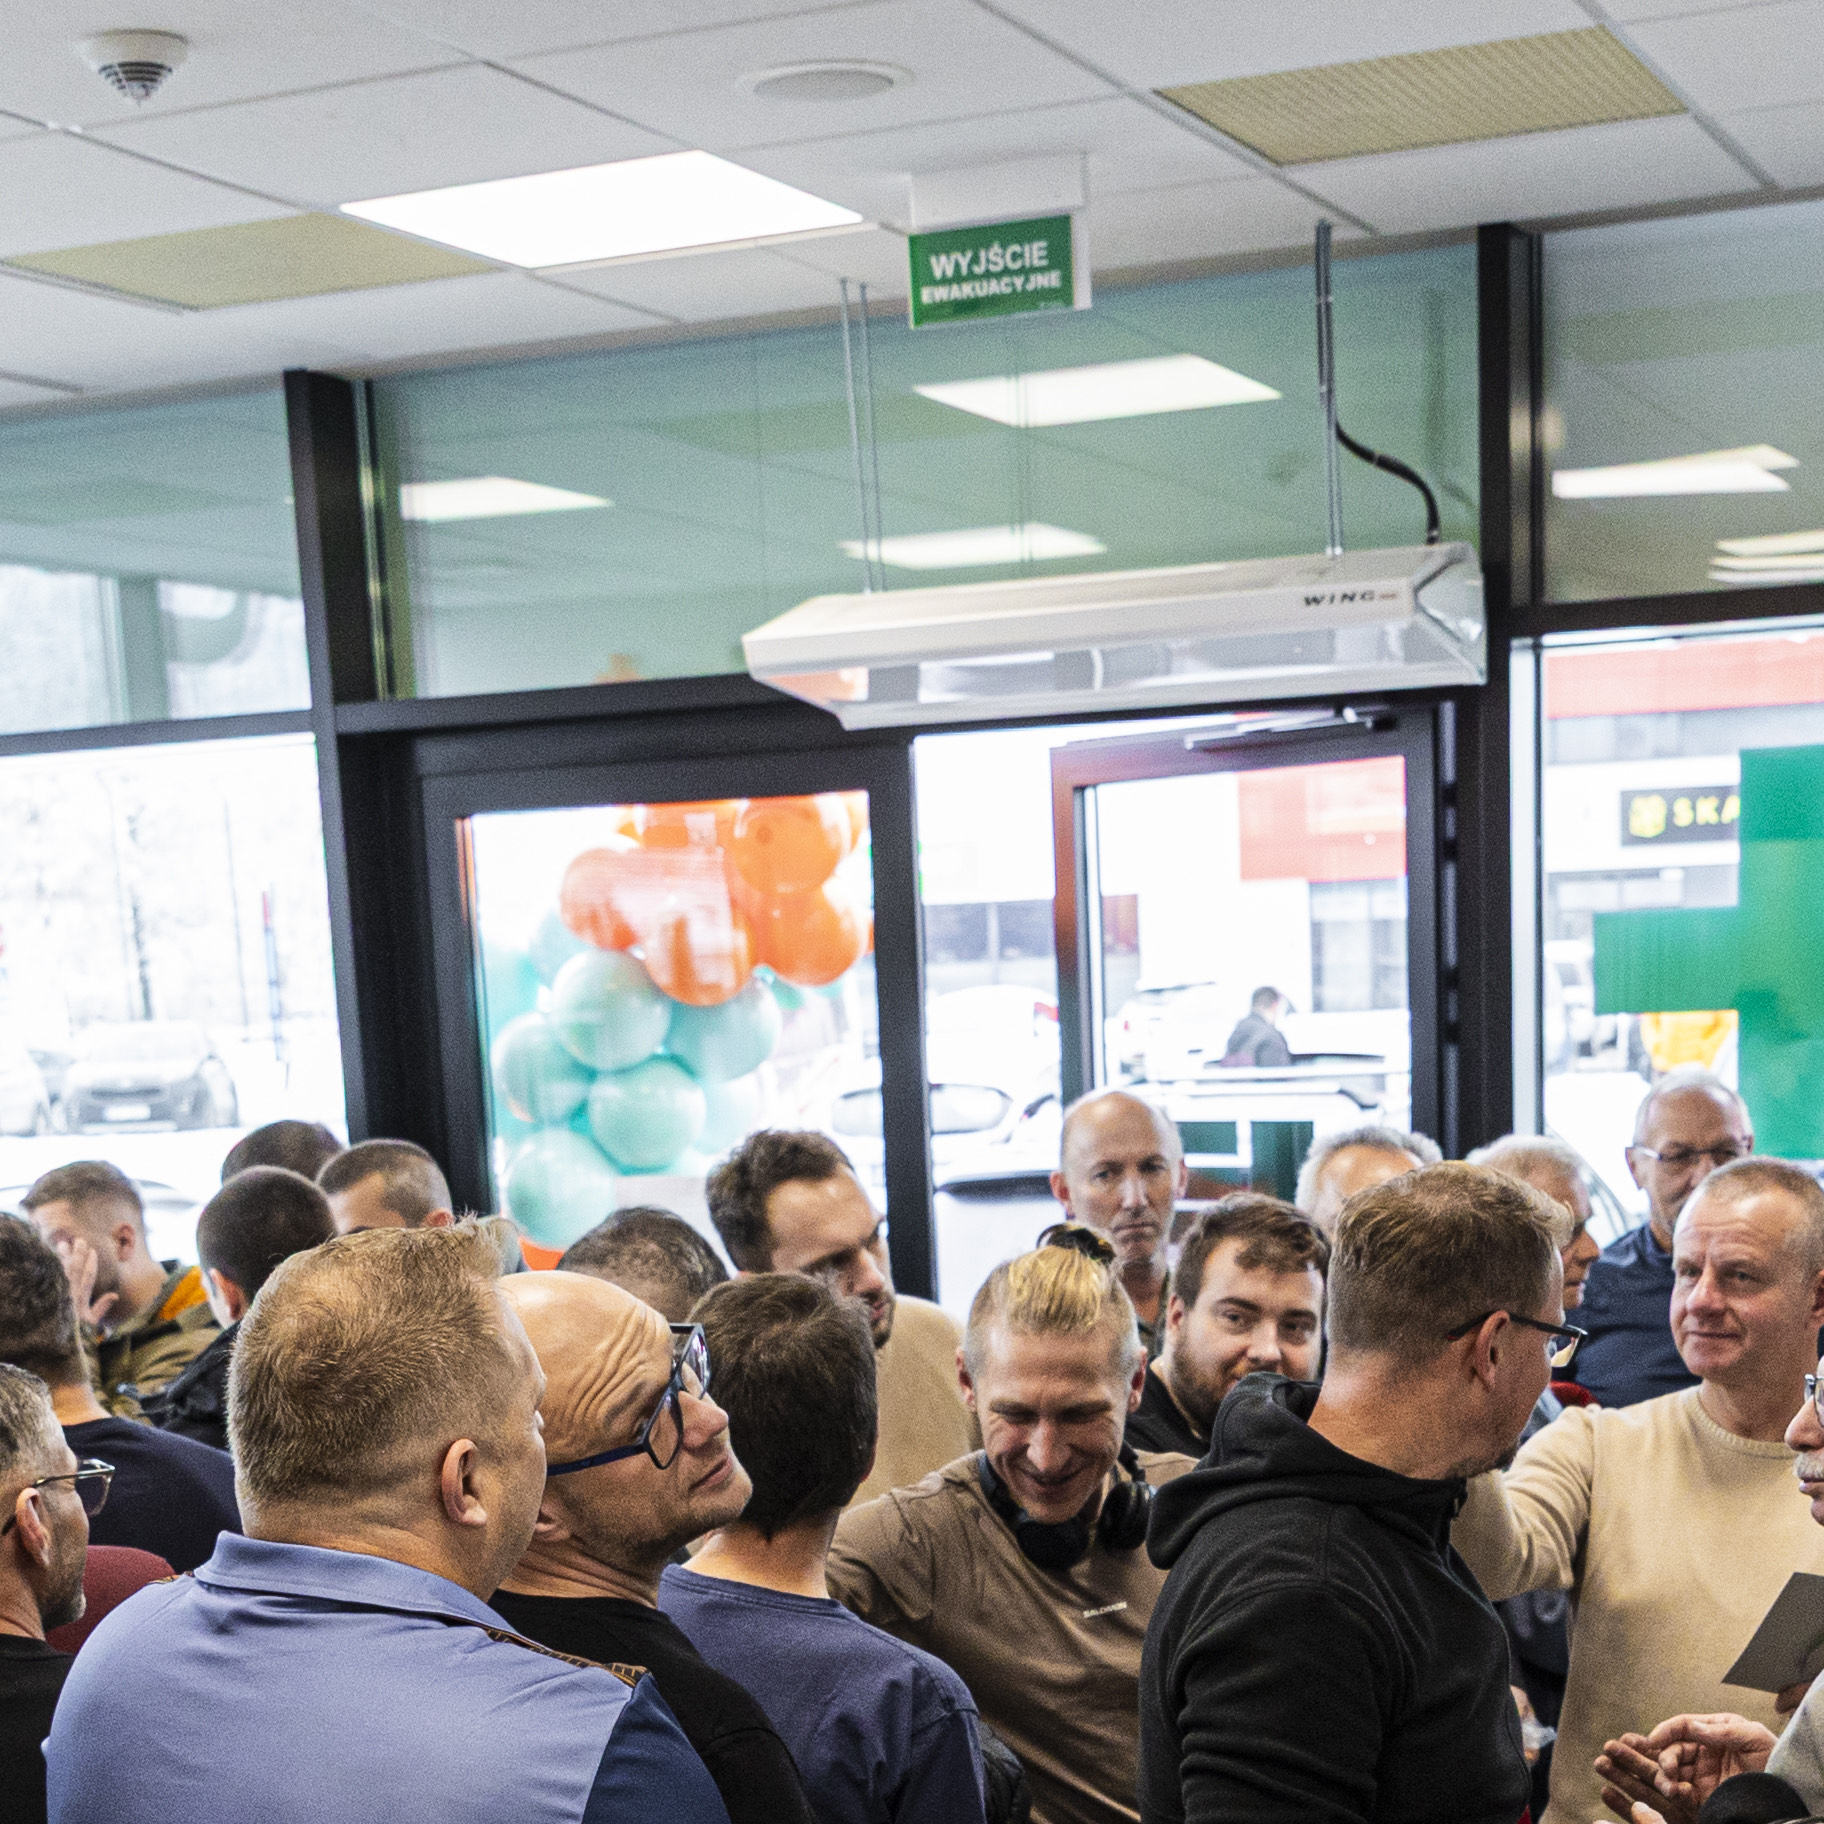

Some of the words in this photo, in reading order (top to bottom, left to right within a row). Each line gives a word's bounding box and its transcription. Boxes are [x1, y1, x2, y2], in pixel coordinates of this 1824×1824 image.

[930, 241, 1049, 280] WYJŚCIE
[921, 270, 1062, 304] EWAKUACYJNE
[1673, 795, 1741, 827] SKA
